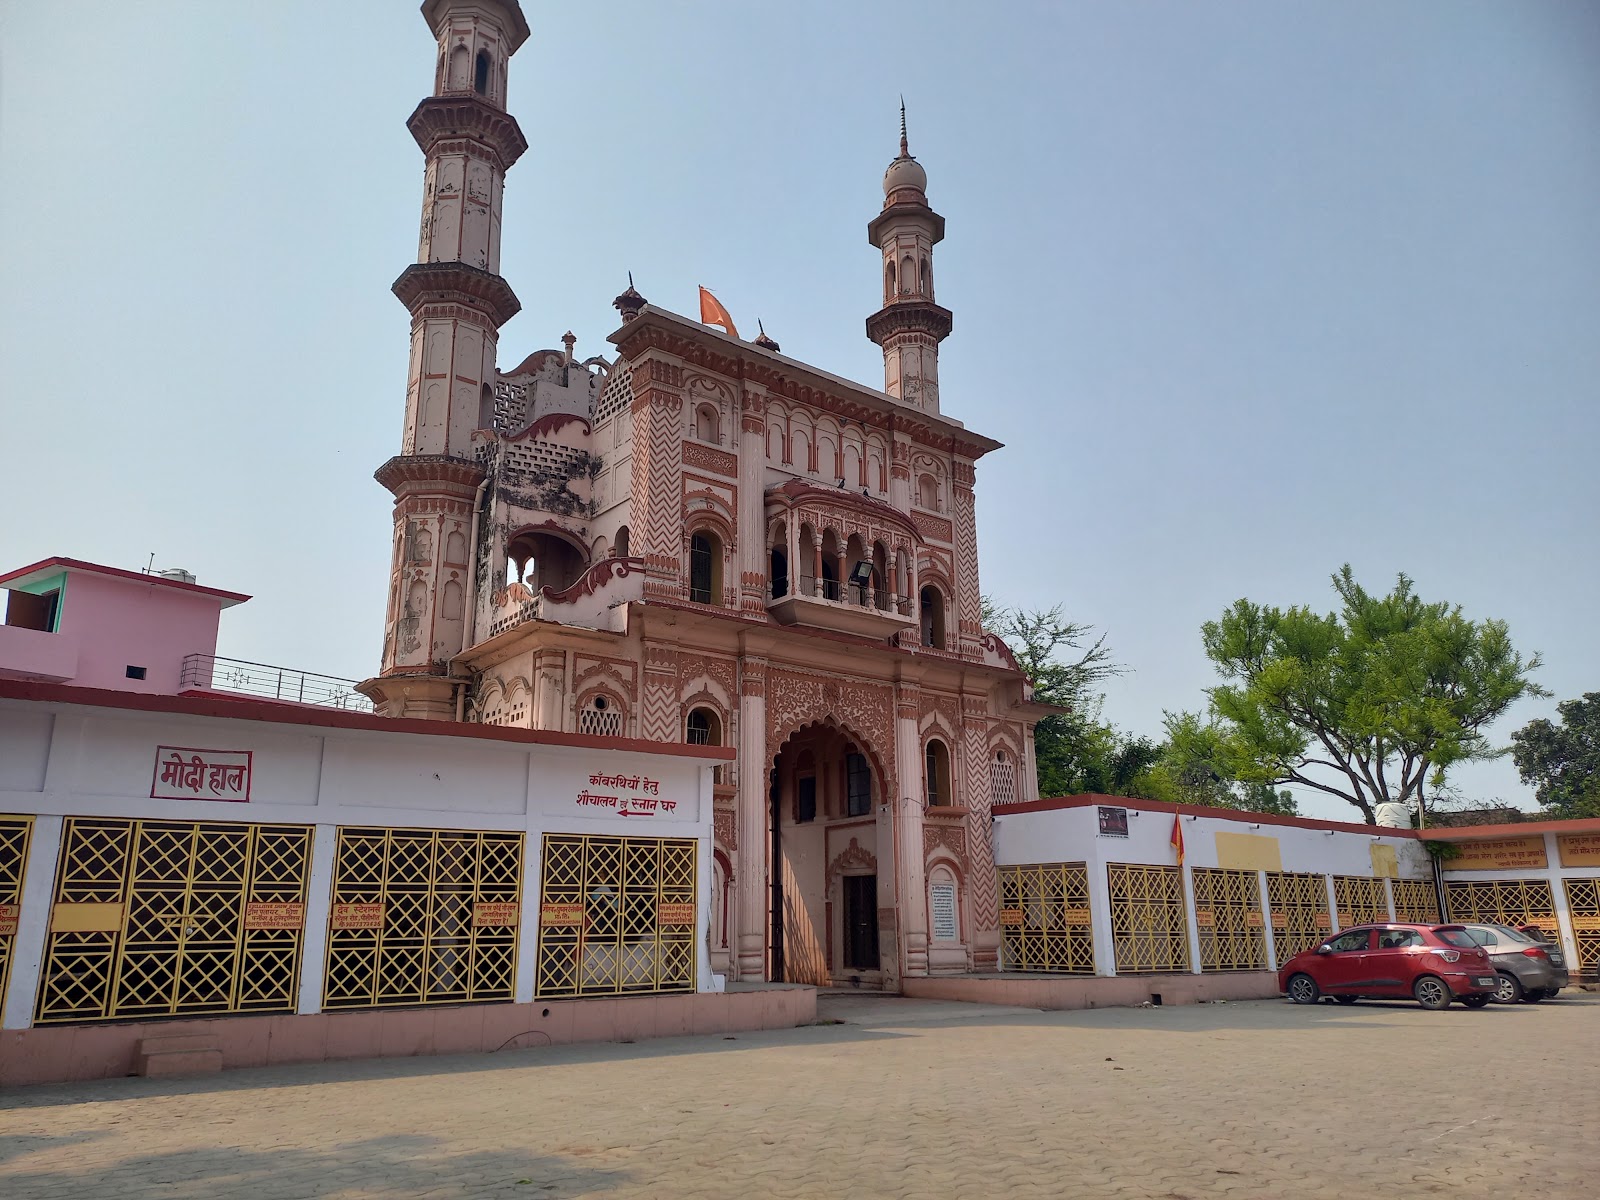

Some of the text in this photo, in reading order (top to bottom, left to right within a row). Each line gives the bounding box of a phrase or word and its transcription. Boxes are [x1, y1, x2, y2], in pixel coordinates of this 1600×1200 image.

[161, 753, 247, 796] मोदी हाल
[643, 777, 659, 796] हेतु
[576, 789, 618, 807] शौचालय
[631, 798, 658, 810] स्नान
[660, 800, 677, 814] घर
[337, 904, 350, 914] देव
